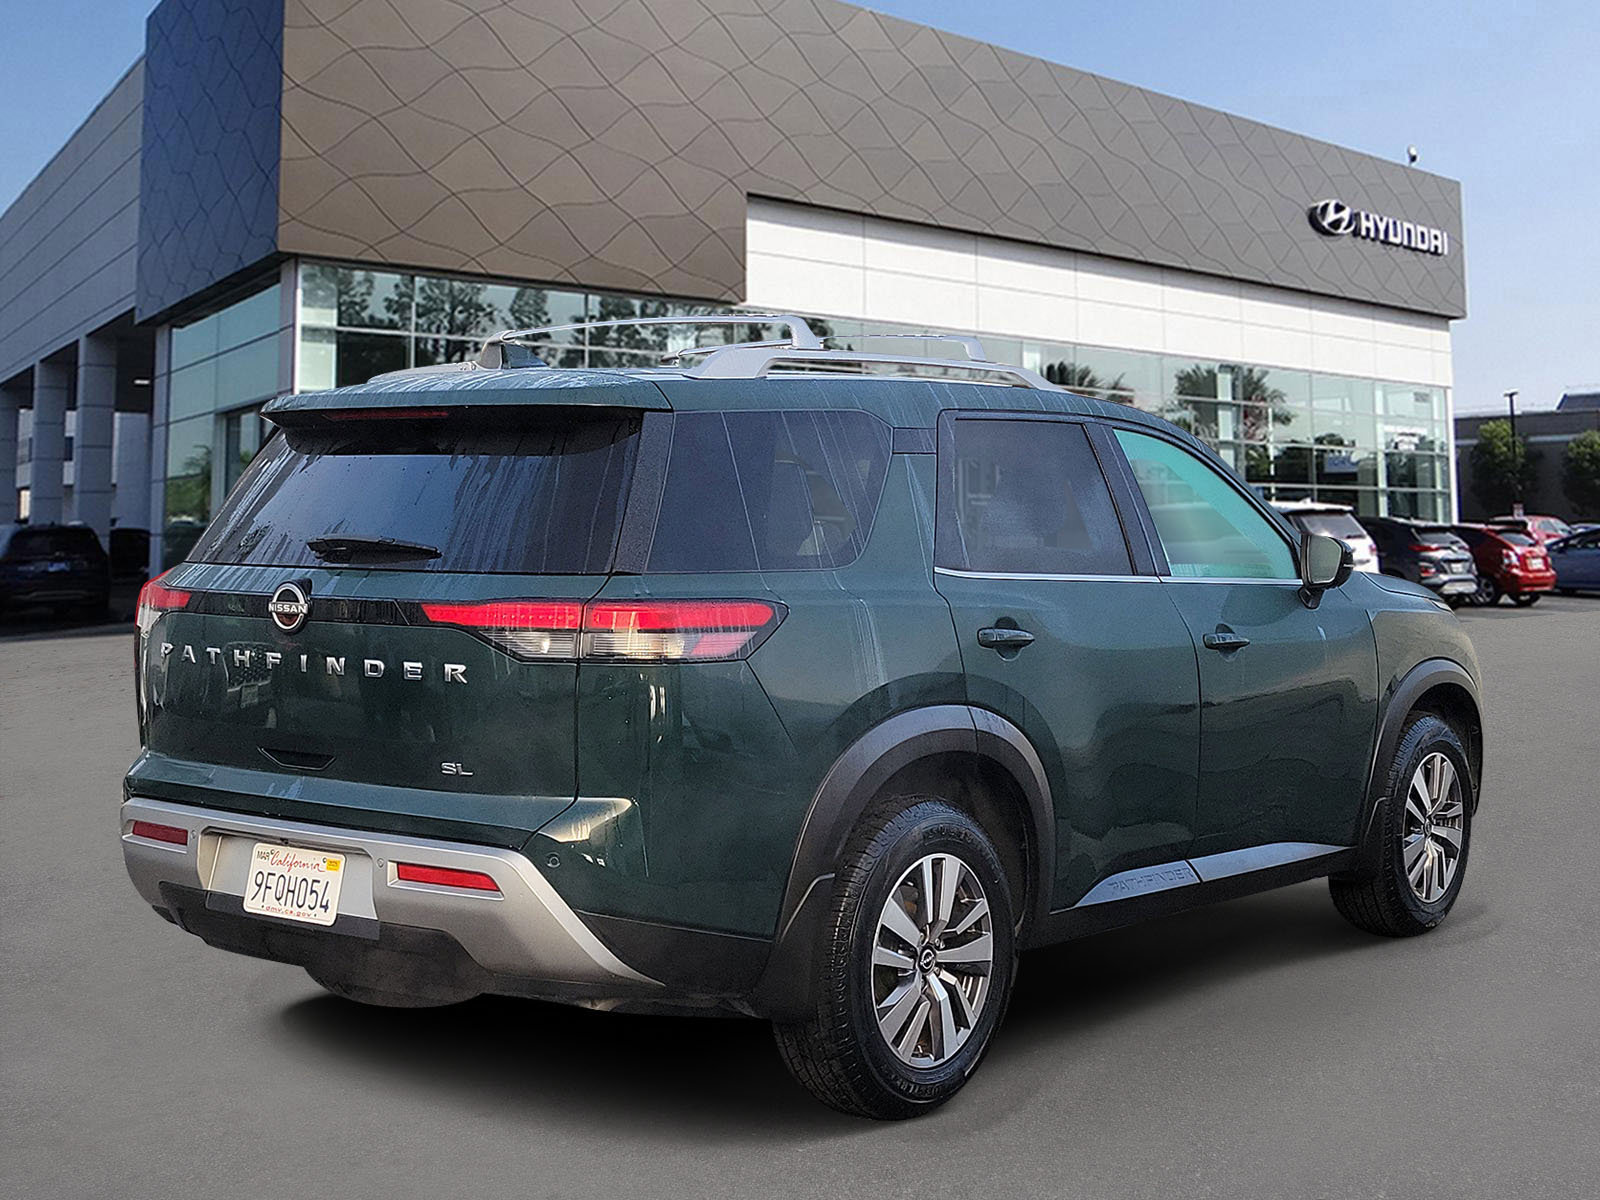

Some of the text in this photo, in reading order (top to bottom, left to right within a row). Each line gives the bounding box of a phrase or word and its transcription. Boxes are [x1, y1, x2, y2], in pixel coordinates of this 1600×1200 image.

[1360, 211, 1448, 255] HYUNDAI
[268, 602, 308, 614] NISSAN
[160, 641, 468, 684] PATHFINDER
[440, 761, 474, 777] SL
[269, 850, 325, 873] California
[250, 870, 330, 914] 9FQH054
